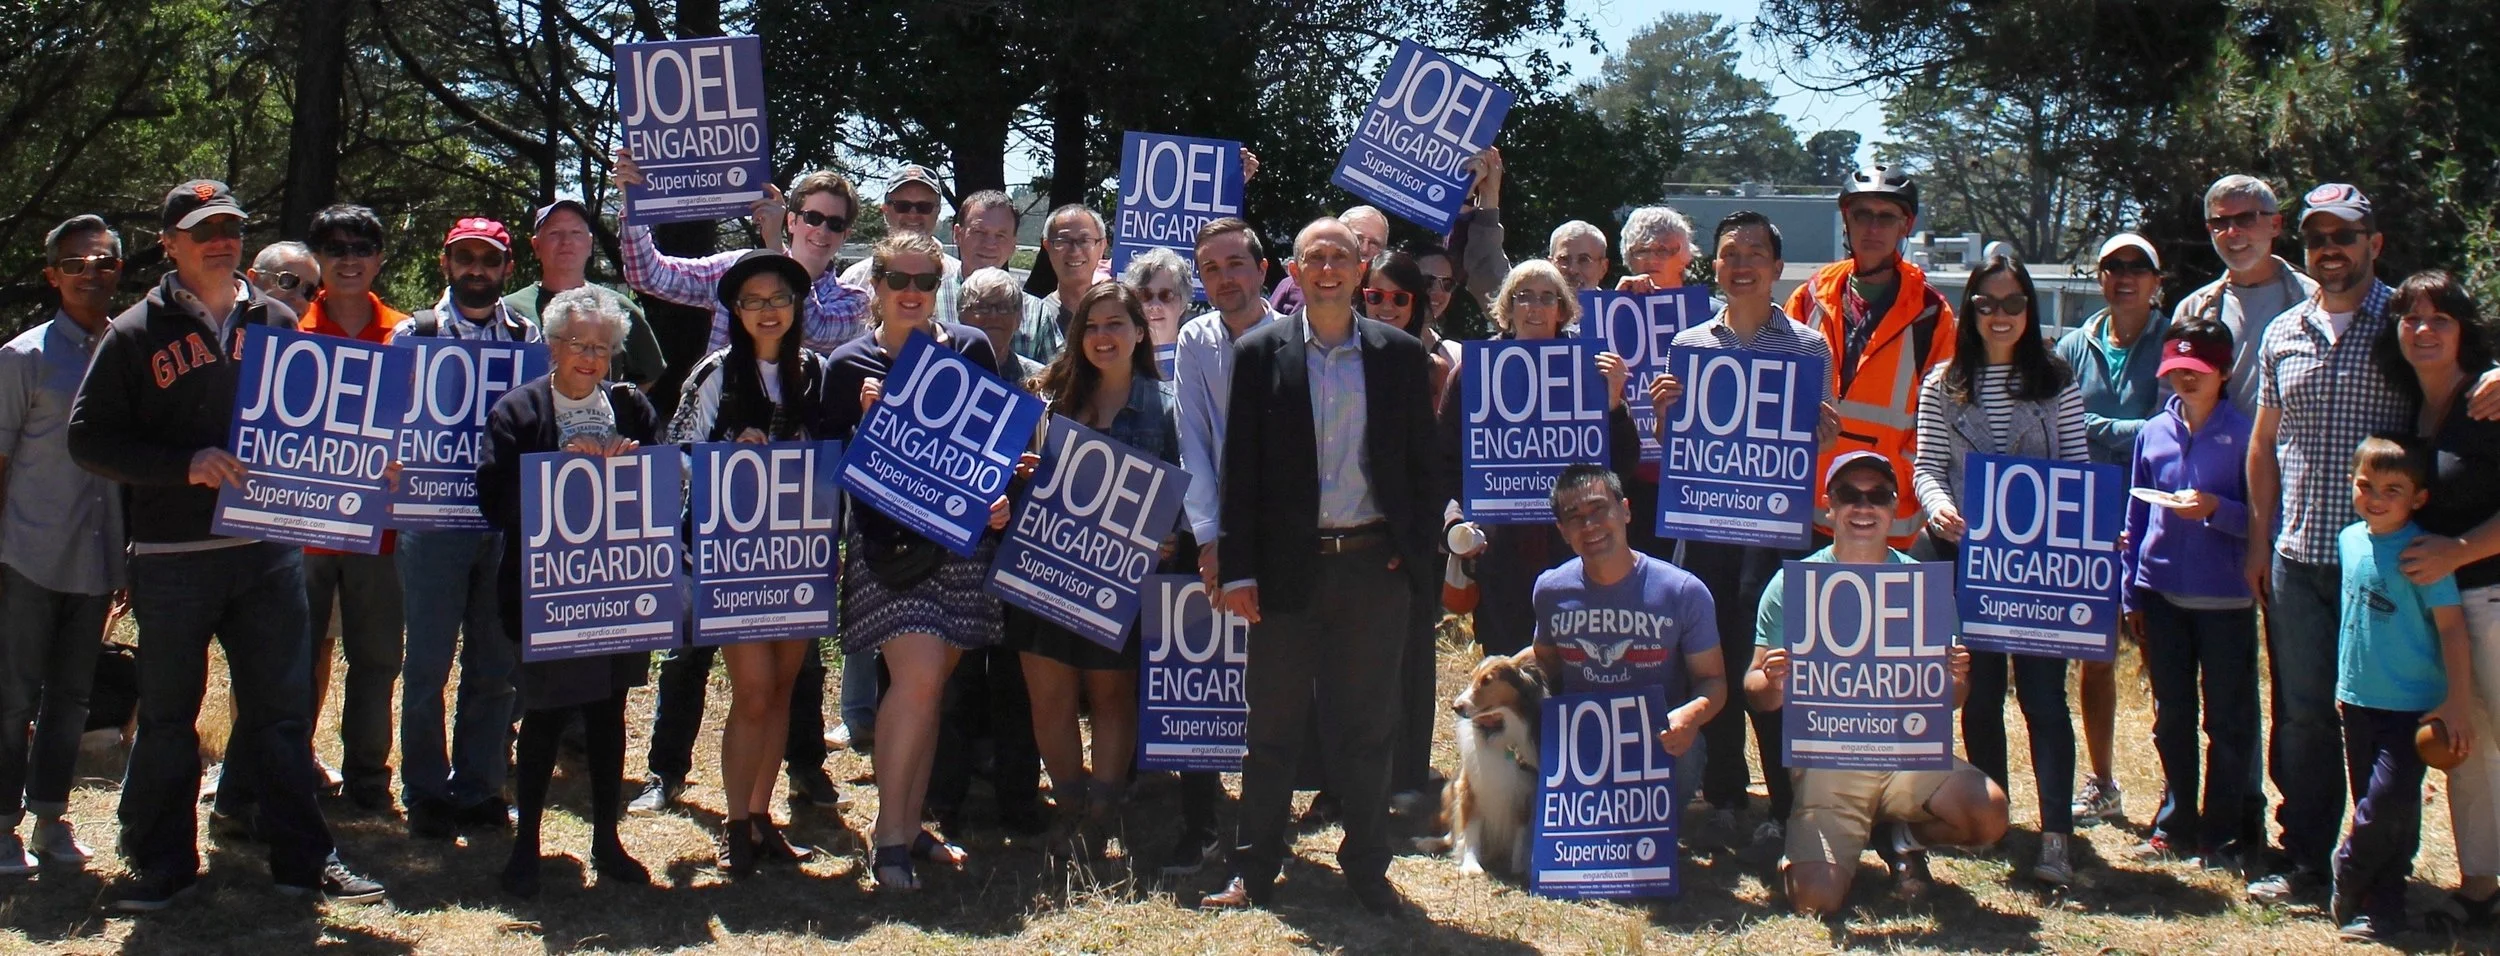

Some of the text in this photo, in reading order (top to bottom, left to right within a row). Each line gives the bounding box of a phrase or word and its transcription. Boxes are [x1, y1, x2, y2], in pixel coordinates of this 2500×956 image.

[627, 45, 757, 125] JOEL
[1378, 49, 1493, 154] JOEL
[629, 123, 760, 161] ENGARDIO
[646, 170, 722, 194] Supervisor
[1124, 139, 1237, 214] JOEL
[1361, 150, 1426, 193] Supervisor
[677, 195, 722, 205] engardio.com
[1121, 210, 1218, 242] ENGAR
[241, 336, 394, 440] JOEL
[1470, 345, 1602, 423] JOEL
[1672, 354, 1811, 442] JOEL
[883, 344, 1019, 467] JOEL
[237, 427, 387, 480] ENGARDIO
[398, 429, 484, 464] ENGA
[868, 406, 1001, 494] ENGARDIO
[1471, 425, 1602, 459] ENGARDIO
[1669, 437, 1809, 480] ENGARDIO
[244, 480, 335, 510] Supervisor
[409, 476, 478, 500] Supervis
[700, 449, 832, 534] JOEL
[866, 450, 944, 505] Supervisor
[1032, 429, 1164, 551] JOEL
[1485, 472, 1559, 495] Superviso
[439, 506, 482, 514] engardio.co
[530, 455, 674, 548] JOEL
[885, 490, 929, 518] engardio.com
[1681, 485, 1763, 511] Supervisor
[1969, 462, 2113, 552] JOEL
[273, 516, 326, 529] engardio.com
[1710, 517, 1758, 528] engardio.com
[701, 535, 830, 574] ENGARDIO
[1017, 501, 1149, 584] ENGARDIO
[531, 543, 673, 588] ENGARDIO
[1016, 550, 1094, 599] Supervisor
[1967, 546, 2112, 591] ENGARDIO
[545, 597, 630, 626] Supervisor
[713, 585, 789, 613] Supervisor
[1037, 589, 1081, 614] engardio.com
[1792, 570, 1946, 657] JOEL
[1979, 594, 2065, 622] Supervisor
[578, 627, 627, 639] engardio.com
[741, 615, 786, 625] engardio.com
[1149, 582, 1247, 663] JOE
[2009, 628, 2059, 639] engardio.com
[1148, 667, 1246, 702] ENGAR
[1584, 666, 1632, 684] Brand
[1792, 661, 1944, 698] ENGARDIO
[1161, 715, 1244, 741] Supervisor
[1807, 710, 1898, 738] Supervisor
[1192, 746, 1240, 754] engardio.com
[1546, 696, 1670, 788] JOEL
[1841, 744, 1894, 753] engardio.com
[1544, 785, 1670, 827] ENGARDIO
[1555, 839, 1632, 867] Supervisor
[1582, 871, 1629, 880] engardio.com
